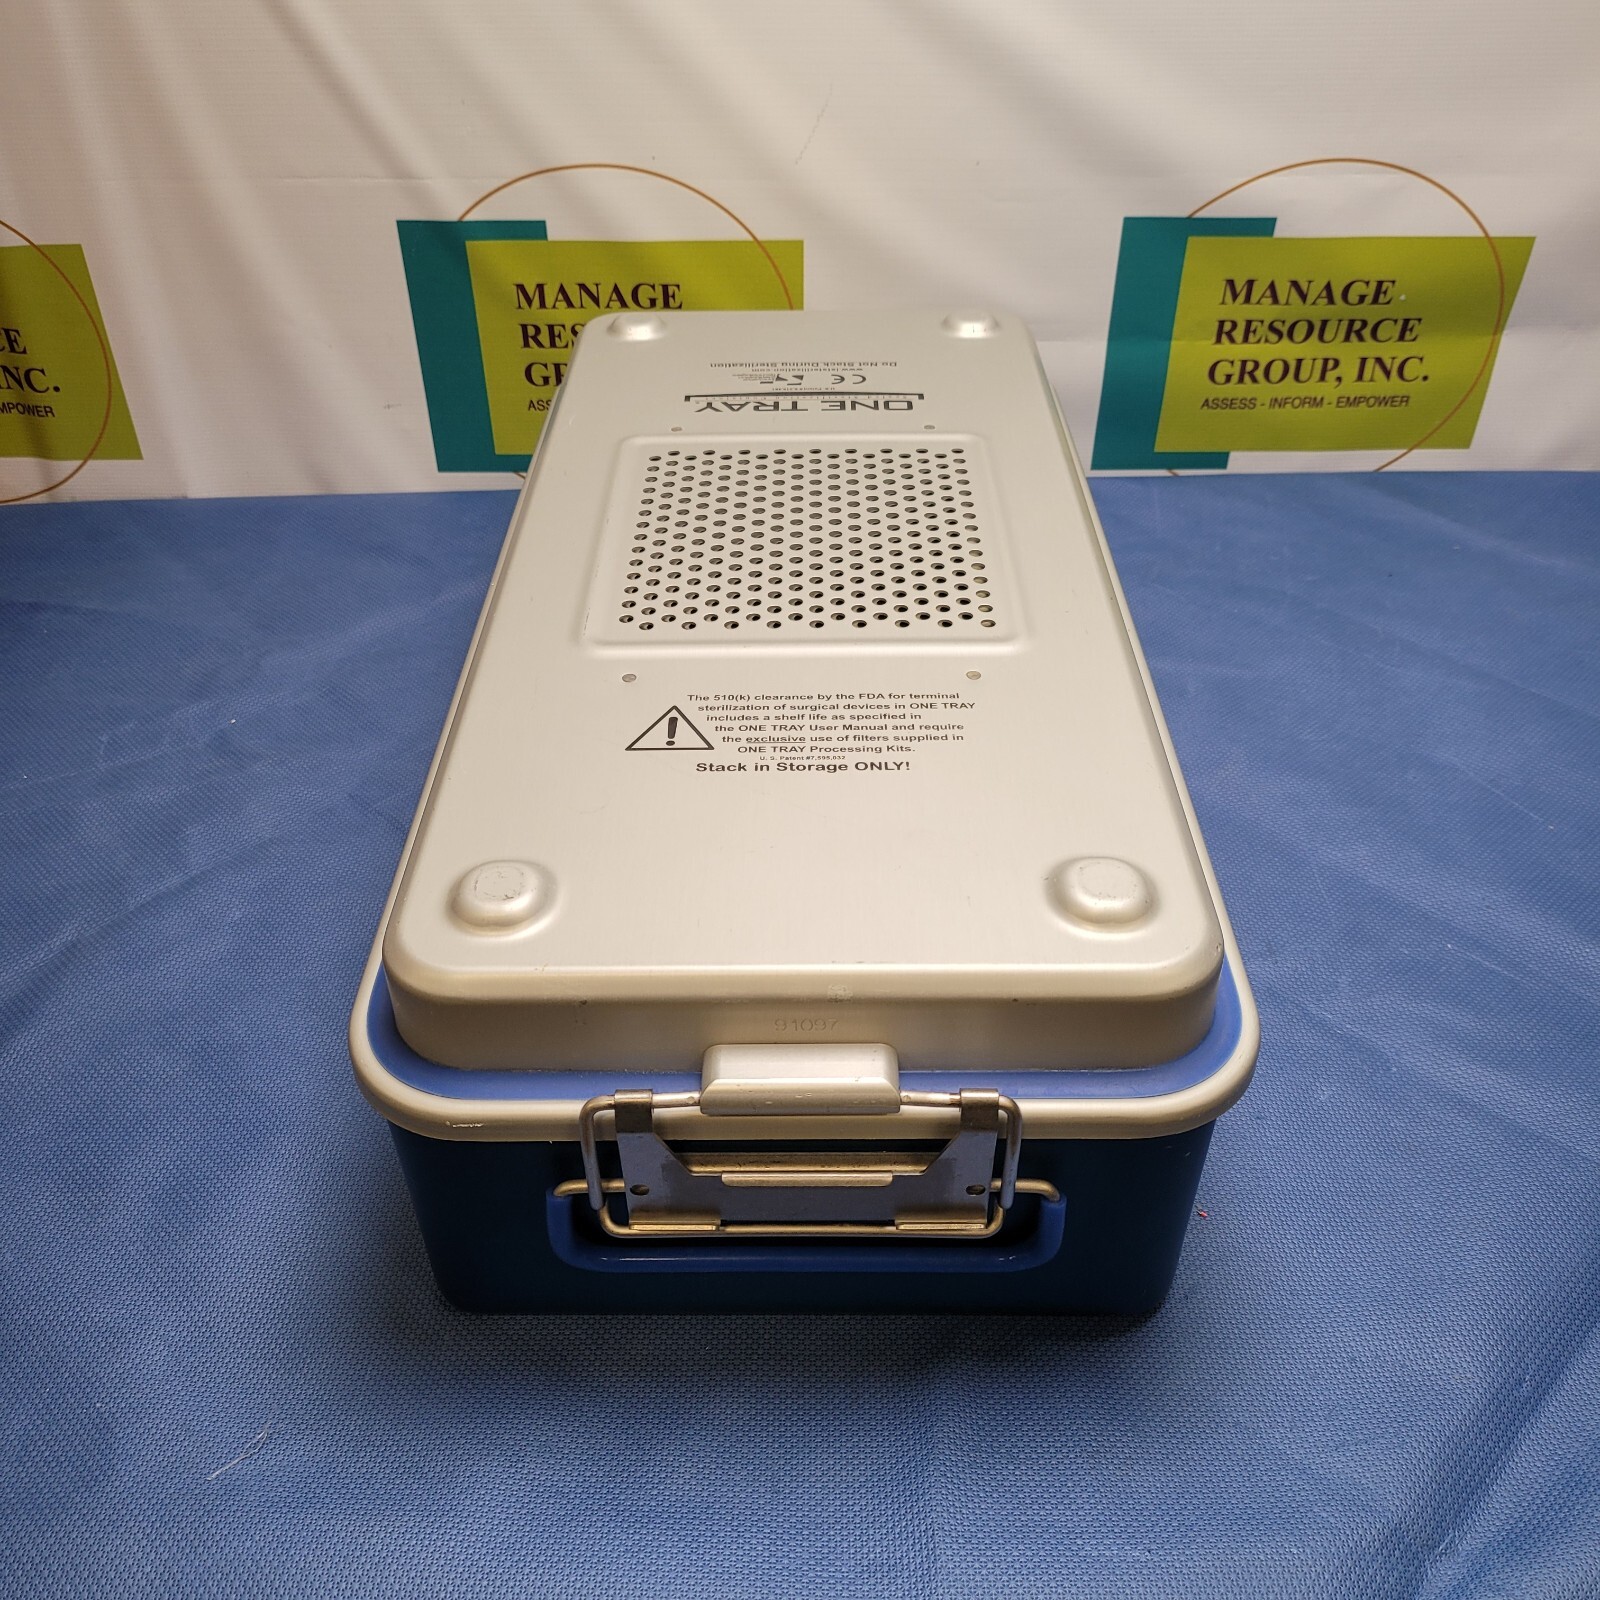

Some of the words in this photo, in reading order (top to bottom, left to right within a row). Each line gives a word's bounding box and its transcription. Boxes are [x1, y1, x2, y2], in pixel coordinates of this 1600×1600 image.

[513, 282, 683, 310] MANAGE
[1220, 279, 1396, 306] MANAGE
[1212, 317, 1422, 345] RESOURCE
[1207, 357, 1343, 389] GROUP,
[1352, 356, 1430, 383] INC.
[0, 365, 60, 393] NC.
[694, 401, 809, 413] TRAY
[820, 400, 913, 411] ONE
[1200, 397, 1257, 410] ASSESS
[1268, 396, 1324, 409] INFORM
[1335, 395, 1410, 408] EMPOWER
[714, 694, 750, 702] 510(k)
[817, 693, 832, 701] by
[698, 704, 770, 712] sterilization
[849, 713, 906, 721] specified
[745, 735, 806, 743] exclusive
[853, 734, 889, 742] filters
[893, 734, 948, 742] supplied
[809, 745, 882, 754] Processing
[696, 763, 747, 772] Stack
[754, 763, 770, 772] in
[776, 762, 848, 773] Storage
[854, 761, 910, 771] ONLY!
[774, 1018, 838, 1031] 91097
